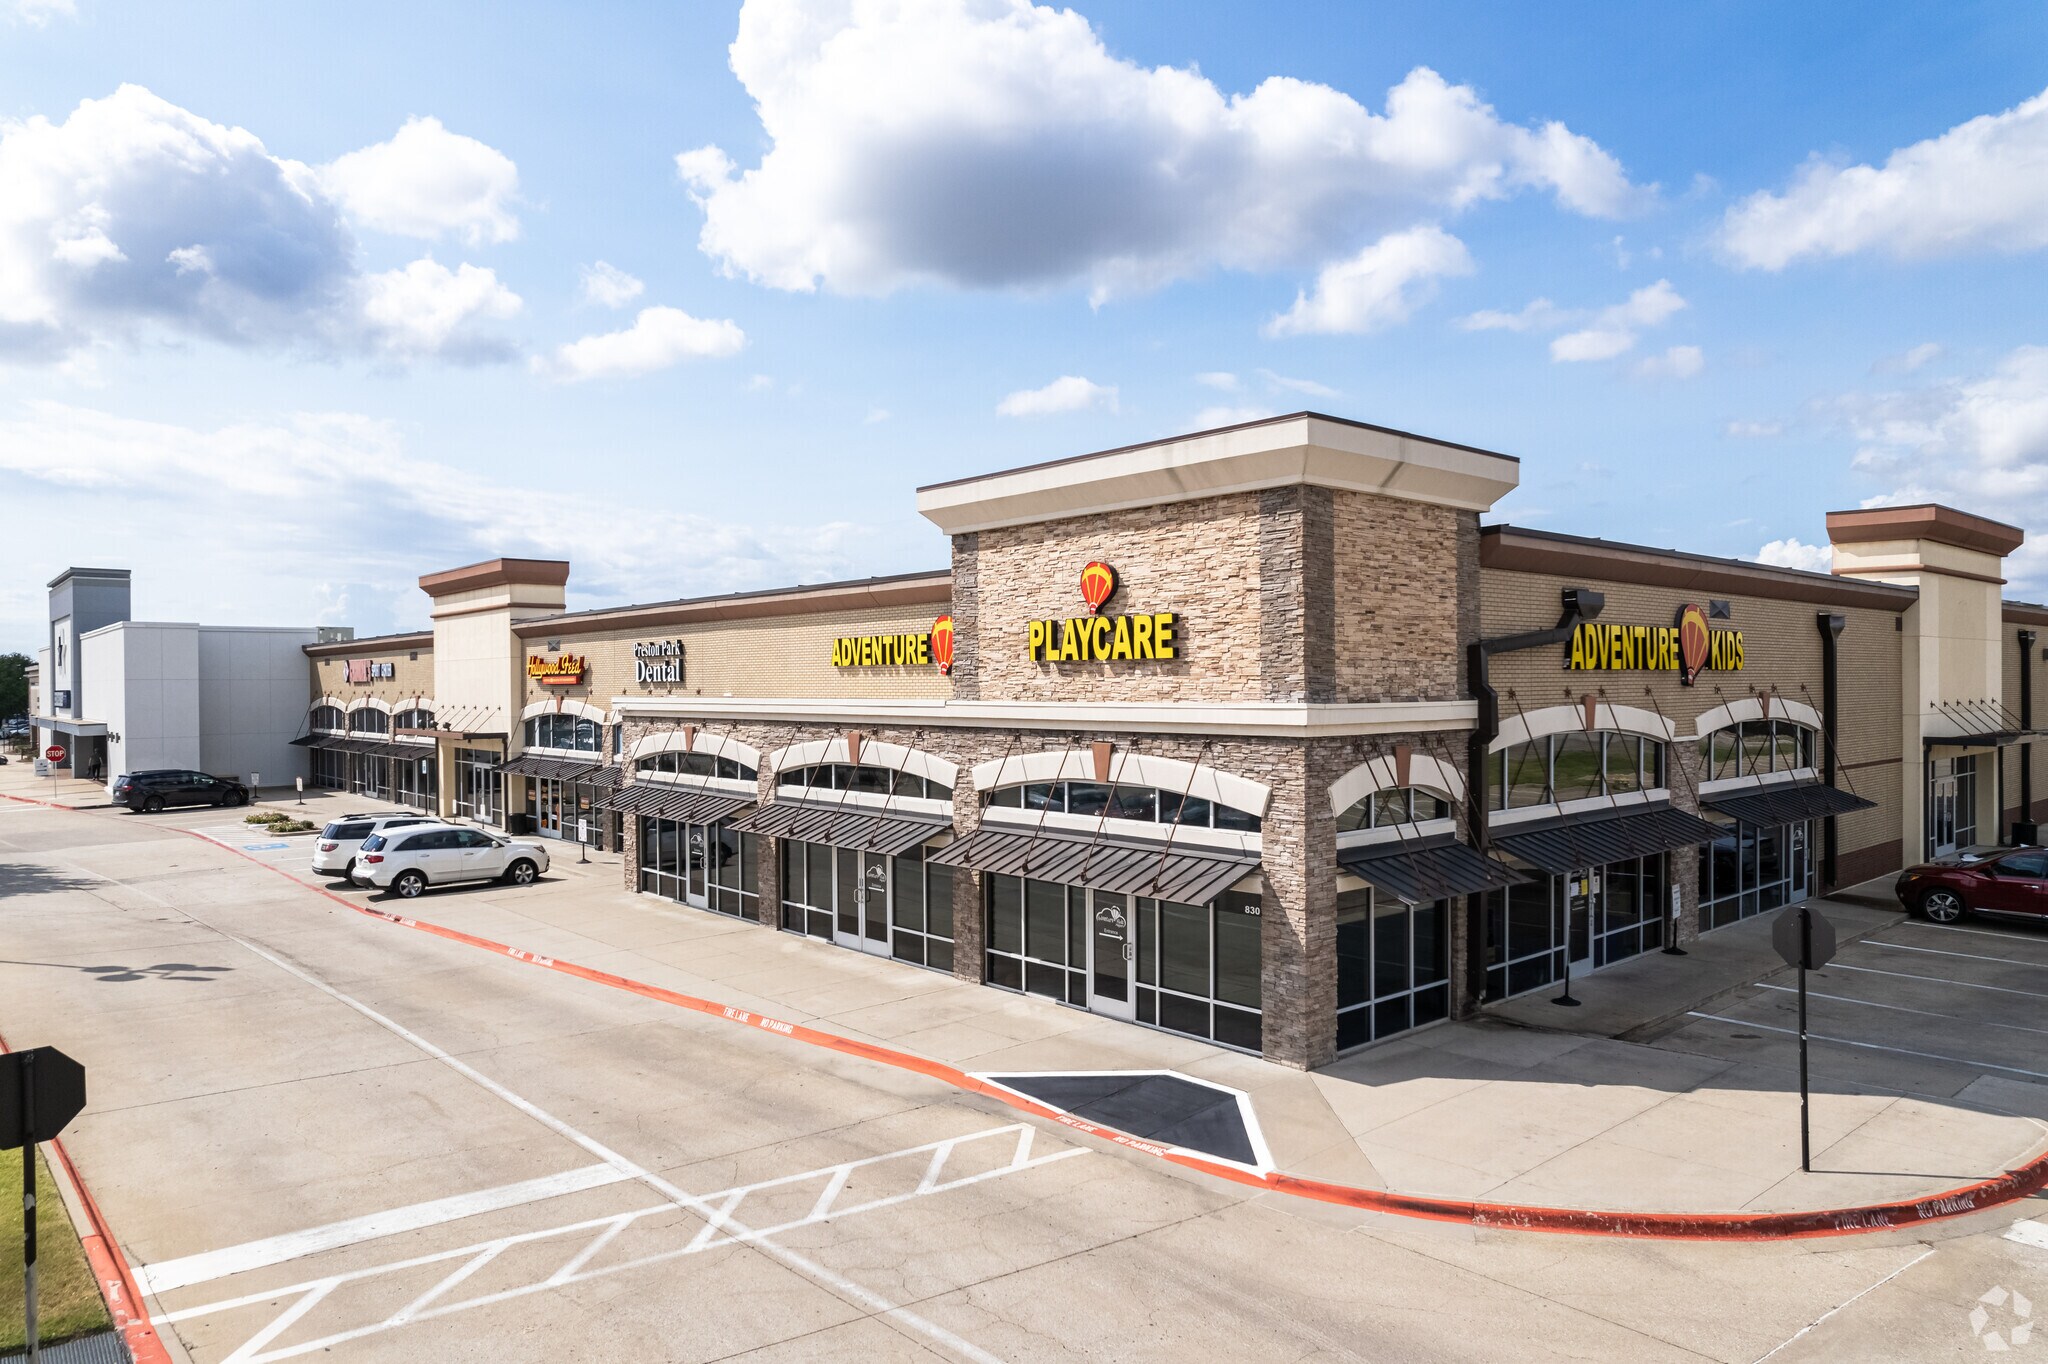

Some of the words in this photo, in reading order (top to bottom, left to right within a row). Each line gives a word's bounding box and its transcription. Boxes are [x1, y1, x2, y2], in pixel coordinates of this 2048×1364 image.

[1028, 613, 1174, 662] PLAYCARE
[1570, 623, 1680, 671] ADVENTURE
[1711, 630, 1745, 671] KIDS
[633, 642, 660, 657] Preston
[661, 640, 681, 656] Park
[831, 634, 929, 667] ADVENTURE
[527, 655, 560, 679] Hollywood
[561, 653, 581, 674] Feed
[635, 658, 681, 682] Dental
[1244, 905, 1261, 915] 830
[723, 1007, 735, 1018] FIRE
[735, 1010, 750, 1022] LANE
[760, 1017, 769, 1027] NO
[768, 1020, 794, 1034] PARKING
[1055, 1115, 1074, 1126] FIRE
[1073, 1119, 1098, 1132] LANE
[1113, 1136, 1127, 1145] NO
[1126, 1140, 1168, 1157] PARKING
[1916, 1203, 1933, 1219] NO
[1932, 1196, 1976, 1216] PARKING
[1834, 1217, 1861, 1231] FIRE
